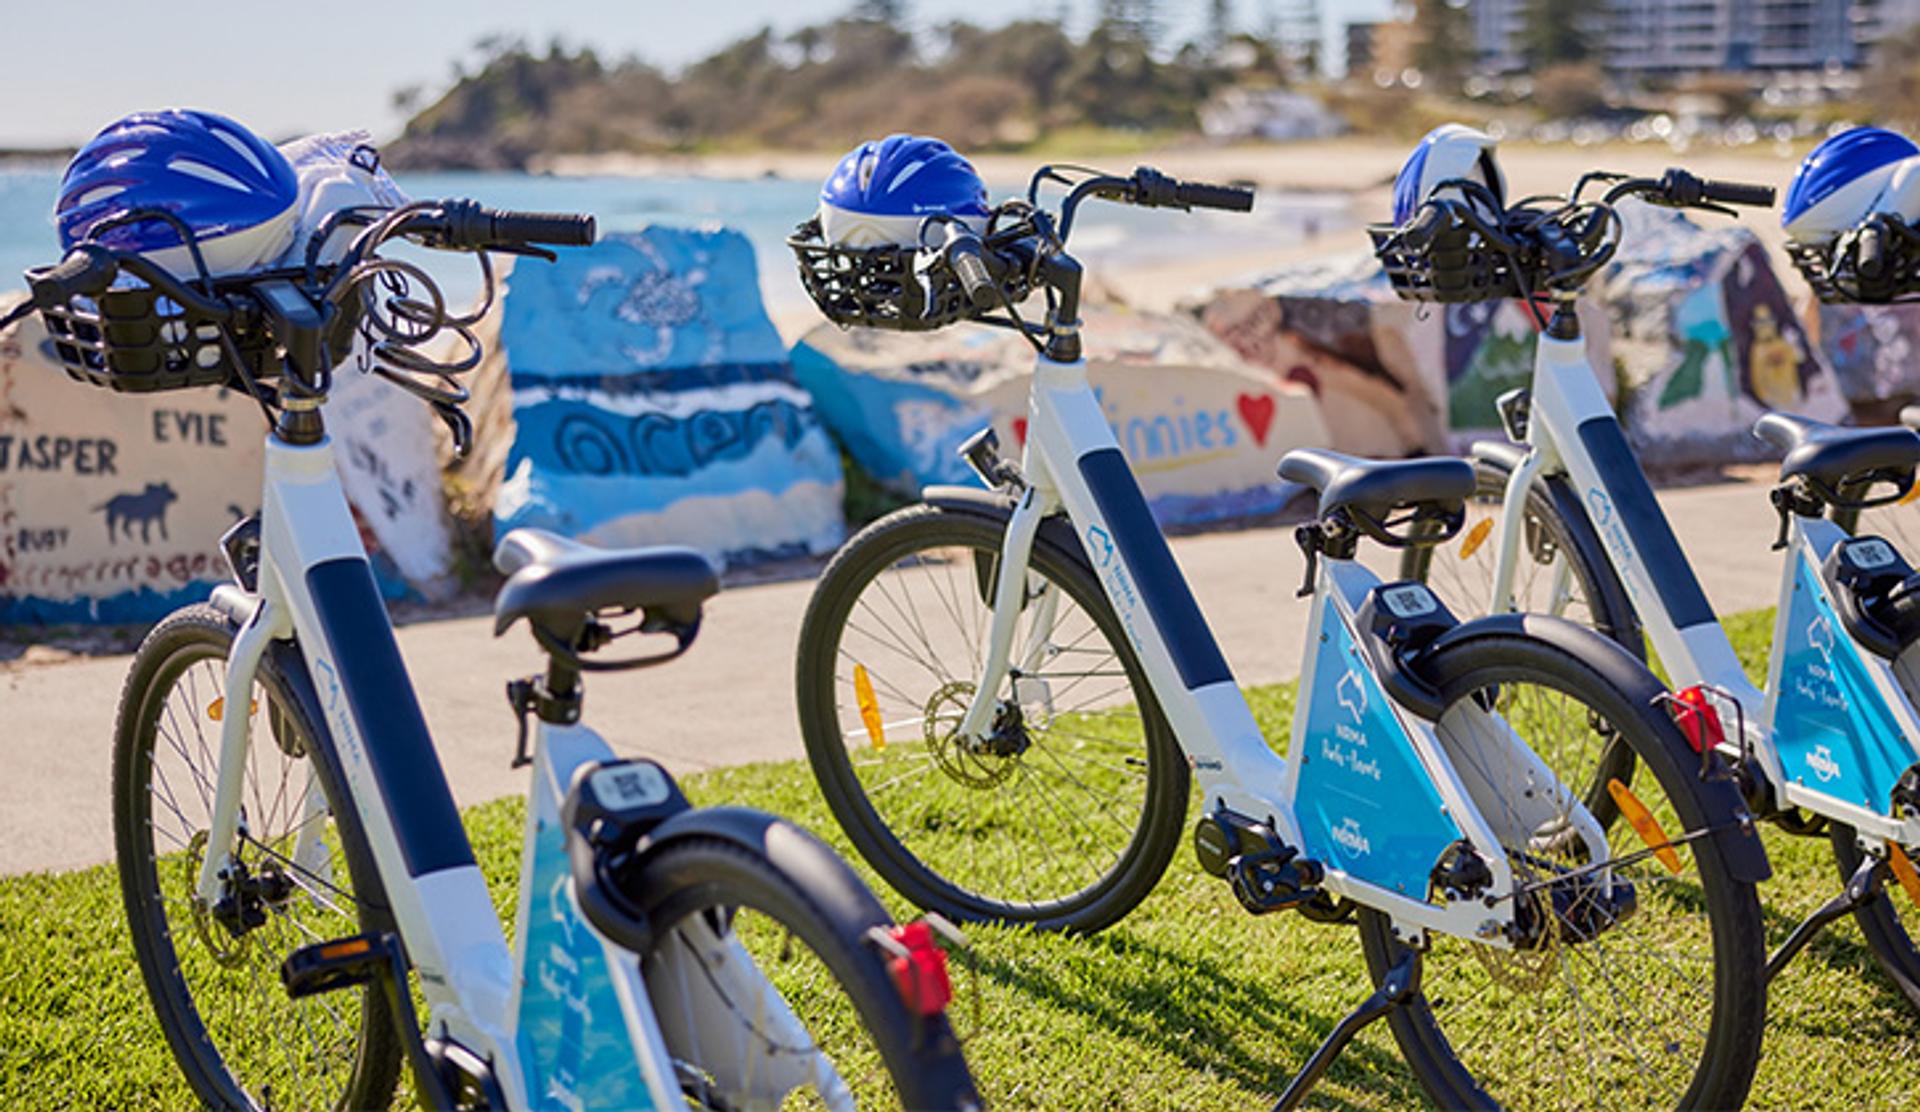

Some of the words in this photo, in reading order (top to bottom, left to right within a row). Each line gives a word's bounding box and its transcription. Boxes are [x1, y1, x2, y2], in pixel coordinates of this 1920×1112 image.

[152, 409, 227, 446] EVIE
[1094, 384, 1238, 459] innies
[0, 434, 118, 474] JASPER
[18, 528, 70, 552] RUBY
